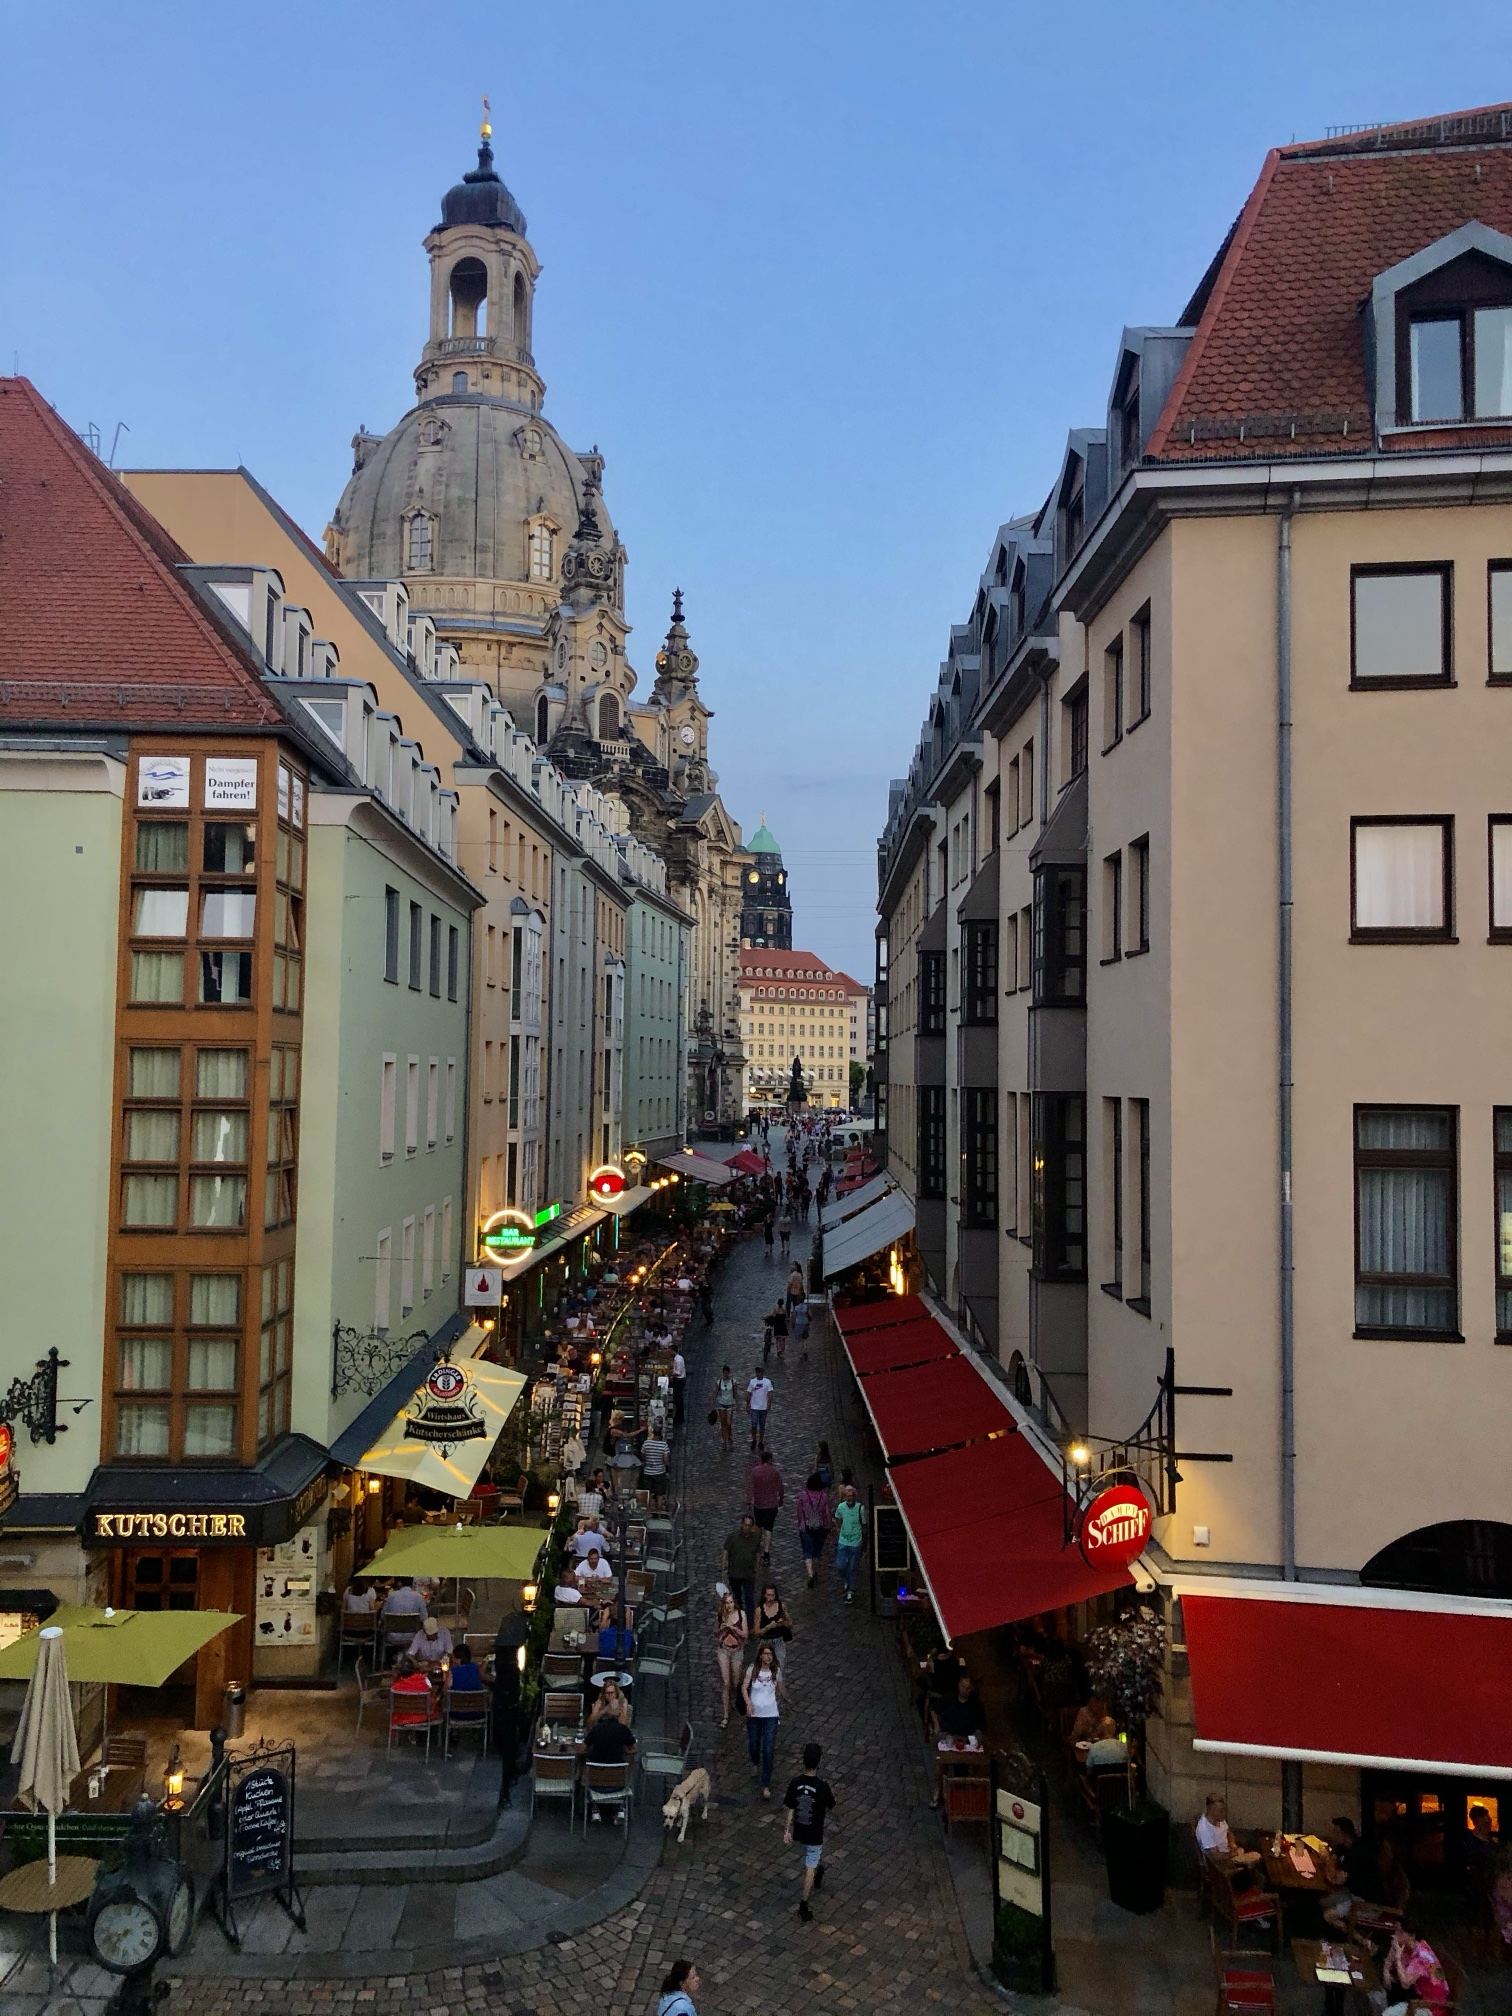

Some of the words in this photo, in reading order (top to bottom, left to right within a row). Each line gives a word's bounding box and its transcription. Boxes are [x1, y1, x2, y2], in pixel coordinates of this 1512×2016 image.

[208, 778, 255, 789] Dampfer
[212, 789, 250, 800] fahren!
[485, 1236, 536, 1246] RESTAURANT
[431, 1368, 462, 1381] ERDINGER
[427, 1411, 466, 1421] Wirtshaus
[408, 1424, 482, 1438] Kutscherschänke
[95, 1513, 246, 1537] KUTSCHER
[245, 1789, 274, 1800] Kuchen
